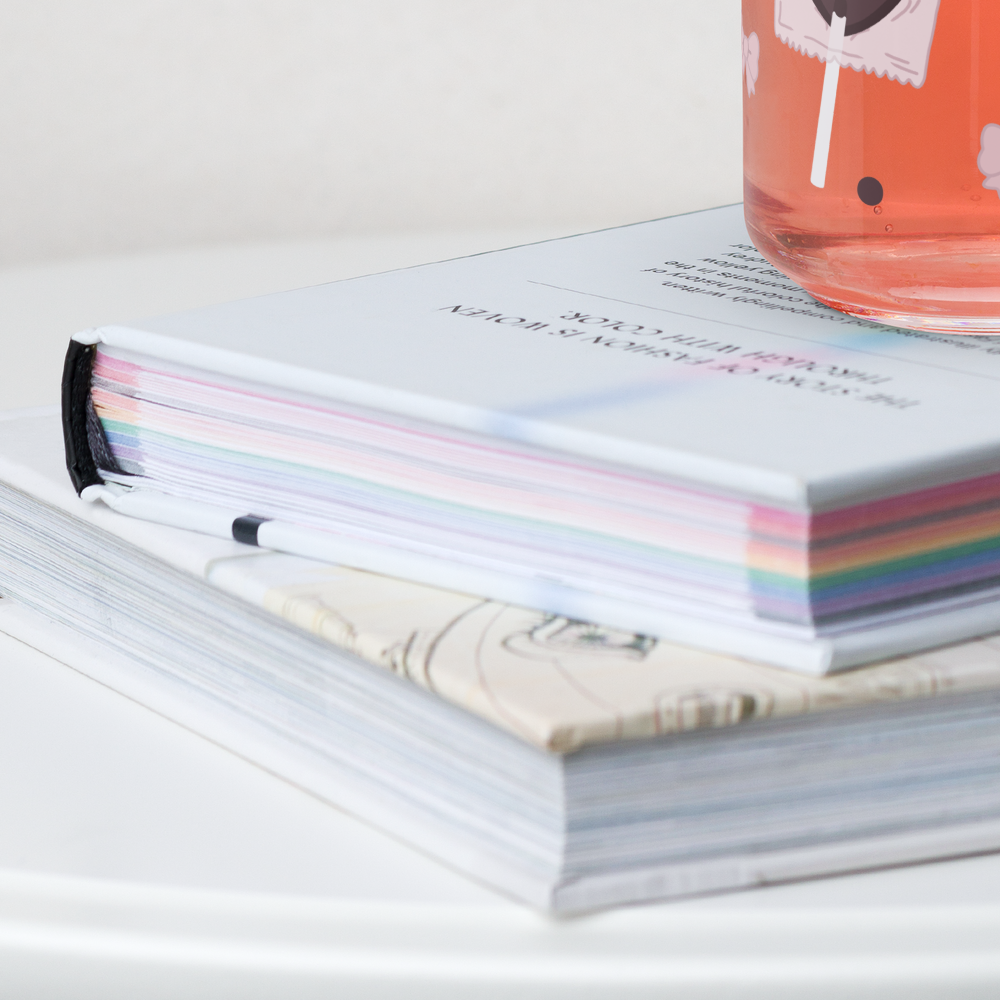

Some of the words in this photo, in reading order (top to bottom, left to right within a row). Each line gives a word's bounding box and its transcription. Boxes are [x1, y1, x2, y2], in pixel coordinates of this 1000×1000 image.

[664, 260, 697, 270] the
[697, 257, 760, 272] yellow
[697, 267, 718, 275] in
[667, 272, 734, 291] history
[717, 271, 804, 293] moments
[727, 285, 804, 303] colorful
[436, 304, 550, 331] WOVEN
[726, 296, 845, 323] compellingly
[560, 310, 663, 336] COLOR.
[548, 328, 587, 339] IS
[659, 333, 741, 354] WITH
[580, 336, 714, 366] FASHION
[707, 363, 760, 375] OF
[741, 350, 893, 385] THROUGH
[760, 373, 860, 396] STORY
[861, 392, 921, 409] THE
